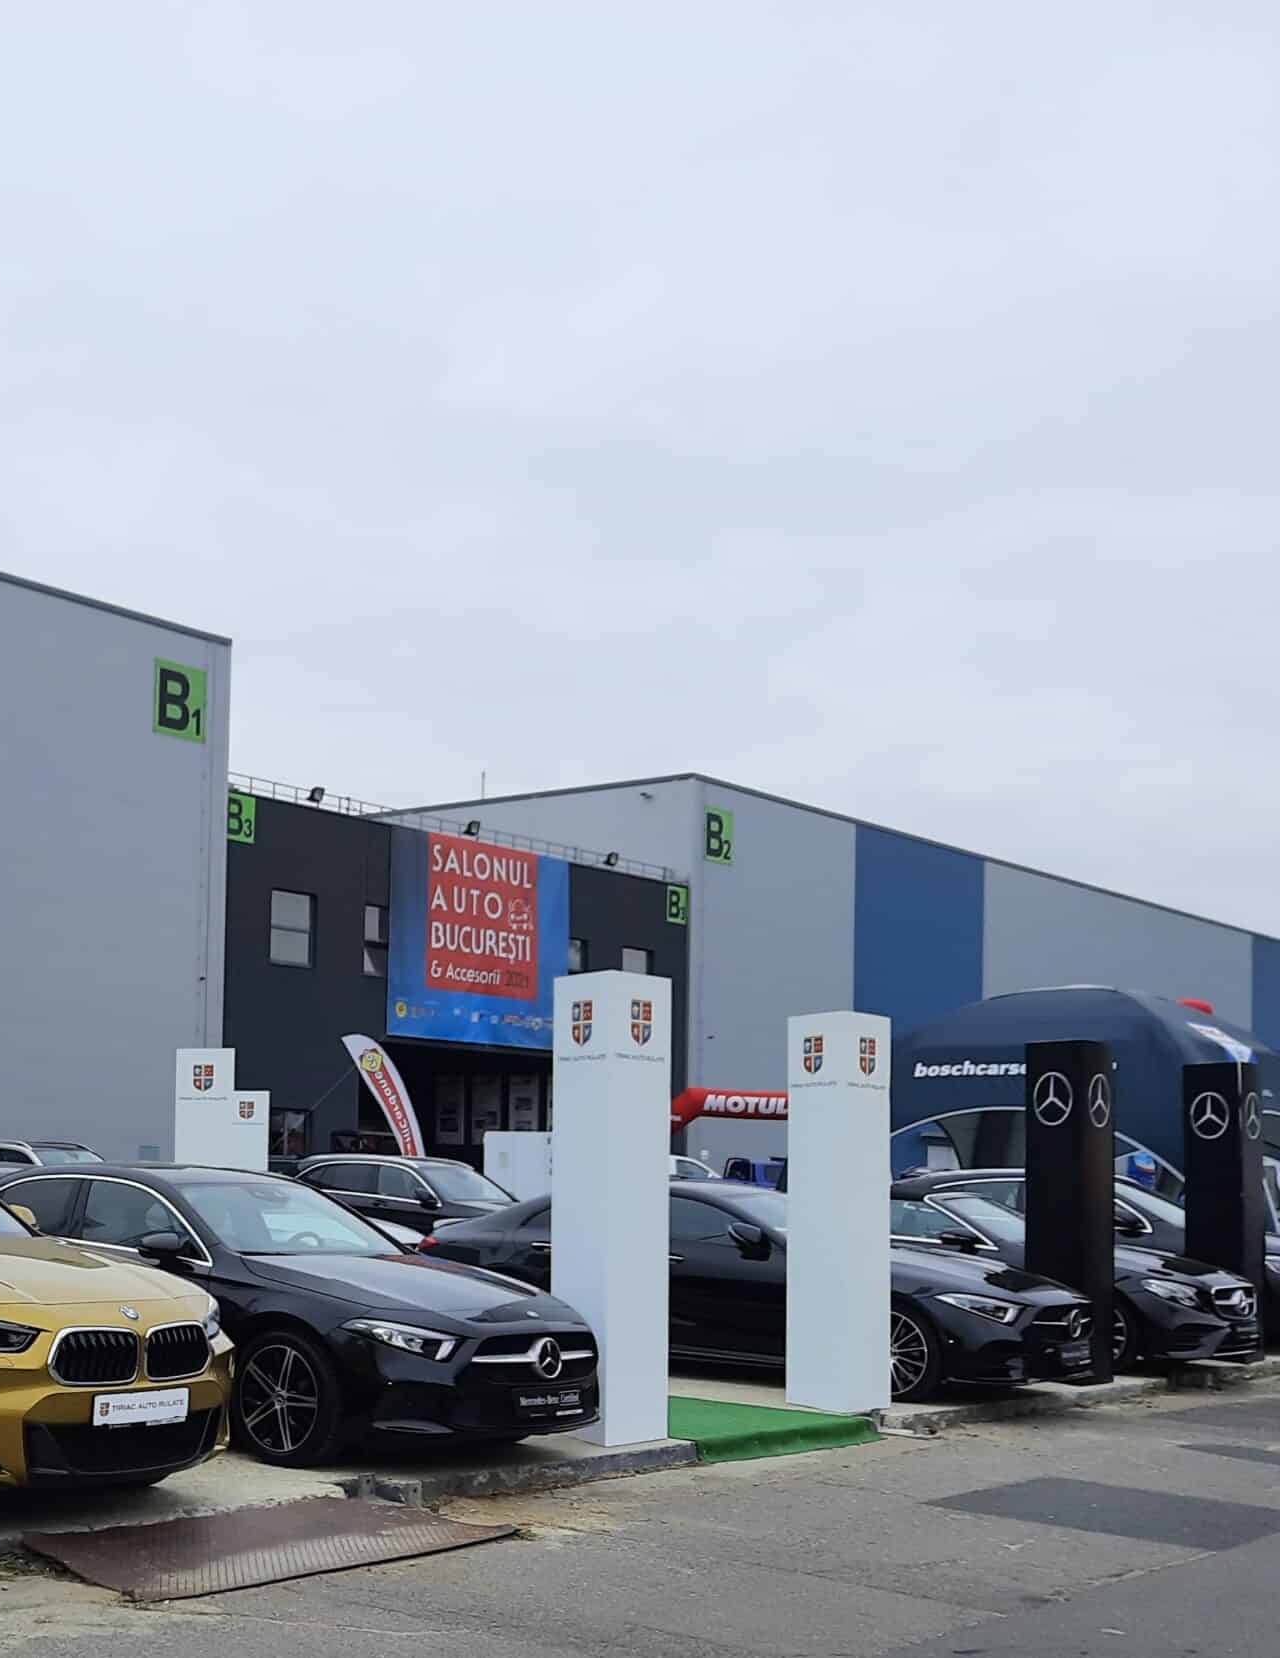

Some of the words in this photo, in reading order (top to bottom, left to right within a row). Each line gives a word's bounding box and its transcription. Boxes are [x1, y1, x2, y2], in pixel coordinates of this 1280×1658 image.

[158, 668, 202, 736] B1
[227, 800, 253, 838] B3
[706, 812, 731, 860] B2
[432, 844, 532, 889] SALONUL
[431, 884, 504, 919] AUTO
[431, 960, 442, 978] &
[446, 963, 501, 986] Accesorii
[703, 1094, 788, 1114] MOTUL
[139, 1401, 158, 1409] AUTO
